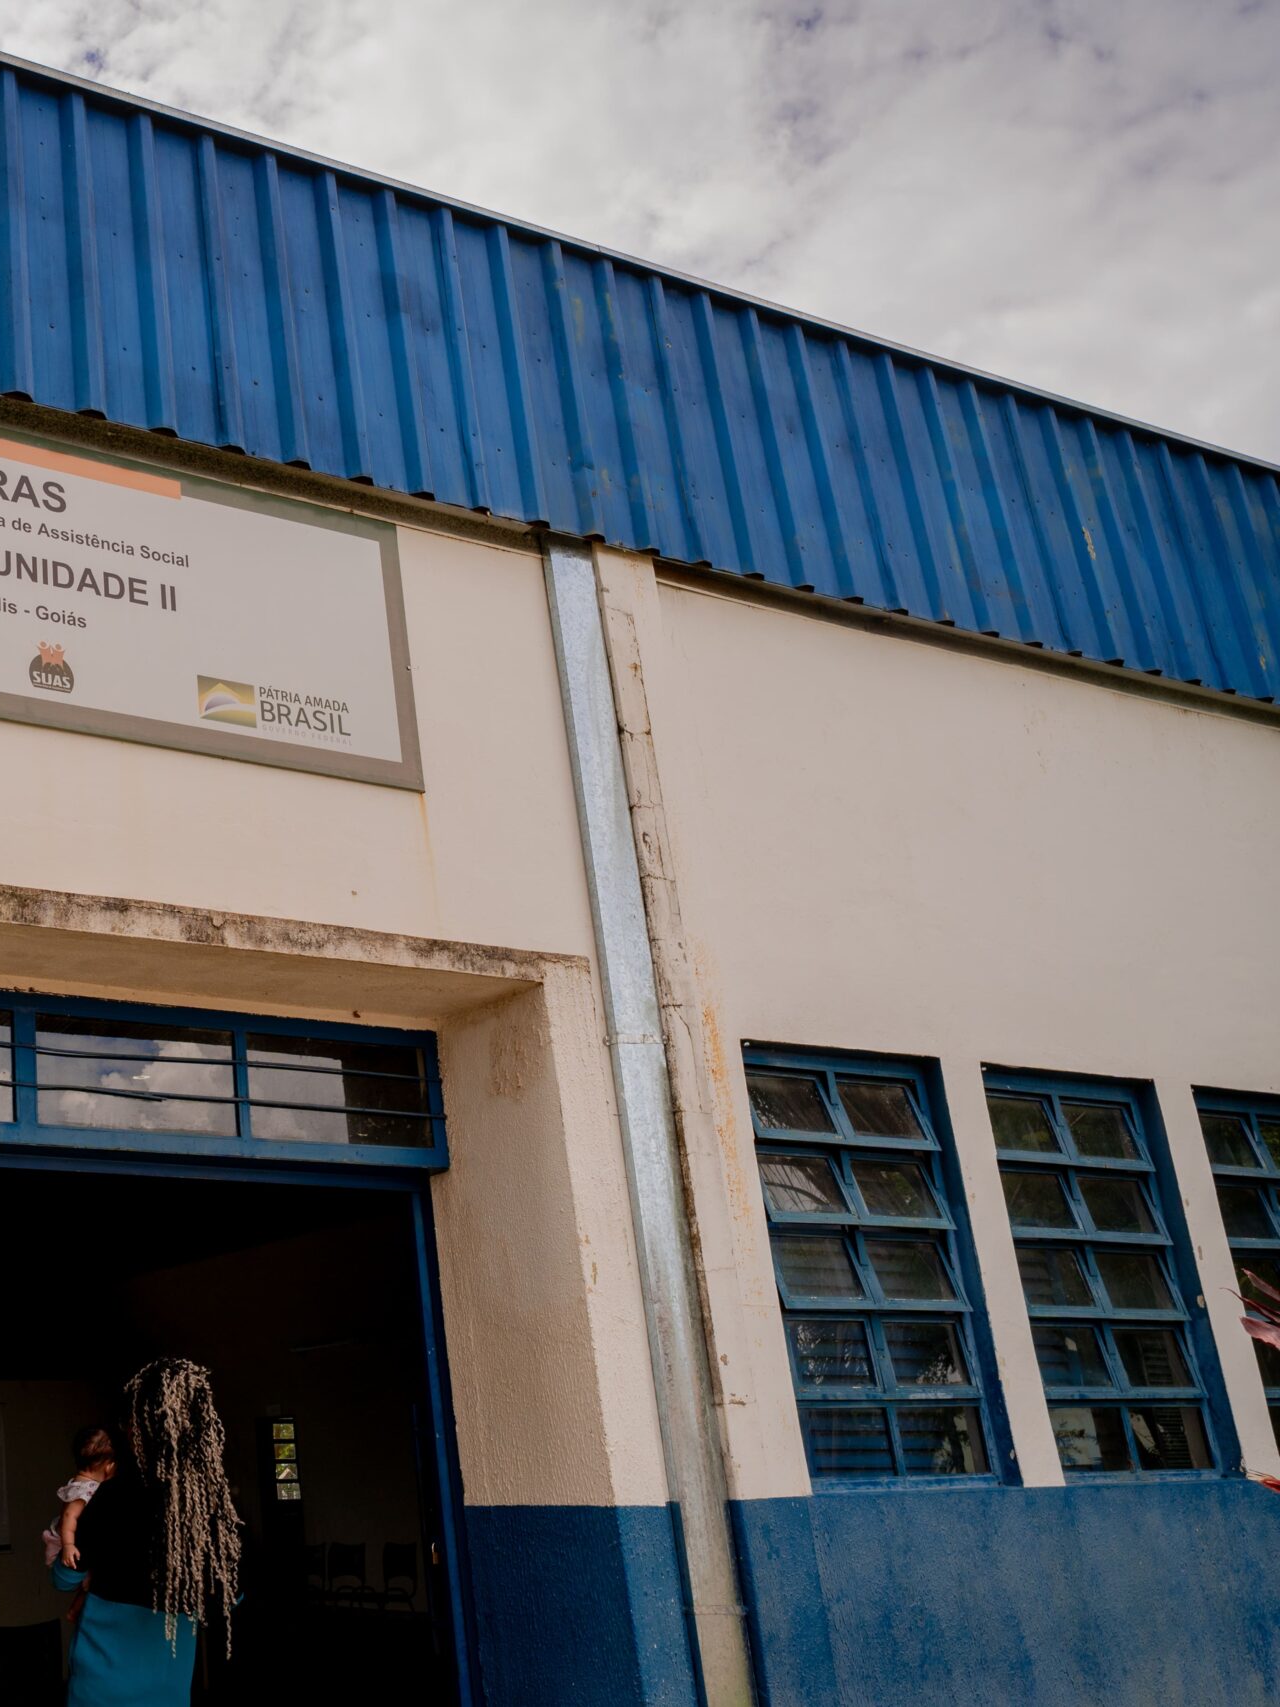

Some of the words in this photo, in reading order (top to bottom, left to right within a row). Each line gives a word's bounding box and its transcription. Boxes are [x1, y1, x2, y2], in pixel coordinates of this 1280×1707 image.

[11, 517, 32, 533] de
[37, 523, 135, 556] Assistência
[140, 545, 190, 568] Social
[160, 583, 177, 611] II
[35, 605, 88, 629] Goiás
[32, 671, 71, 689] SUAS
[259, 686, 301, 705] PÁTRIA
[304, 695, 349, 714] AMADA
[260, 700, 351, 737] BRASIL
